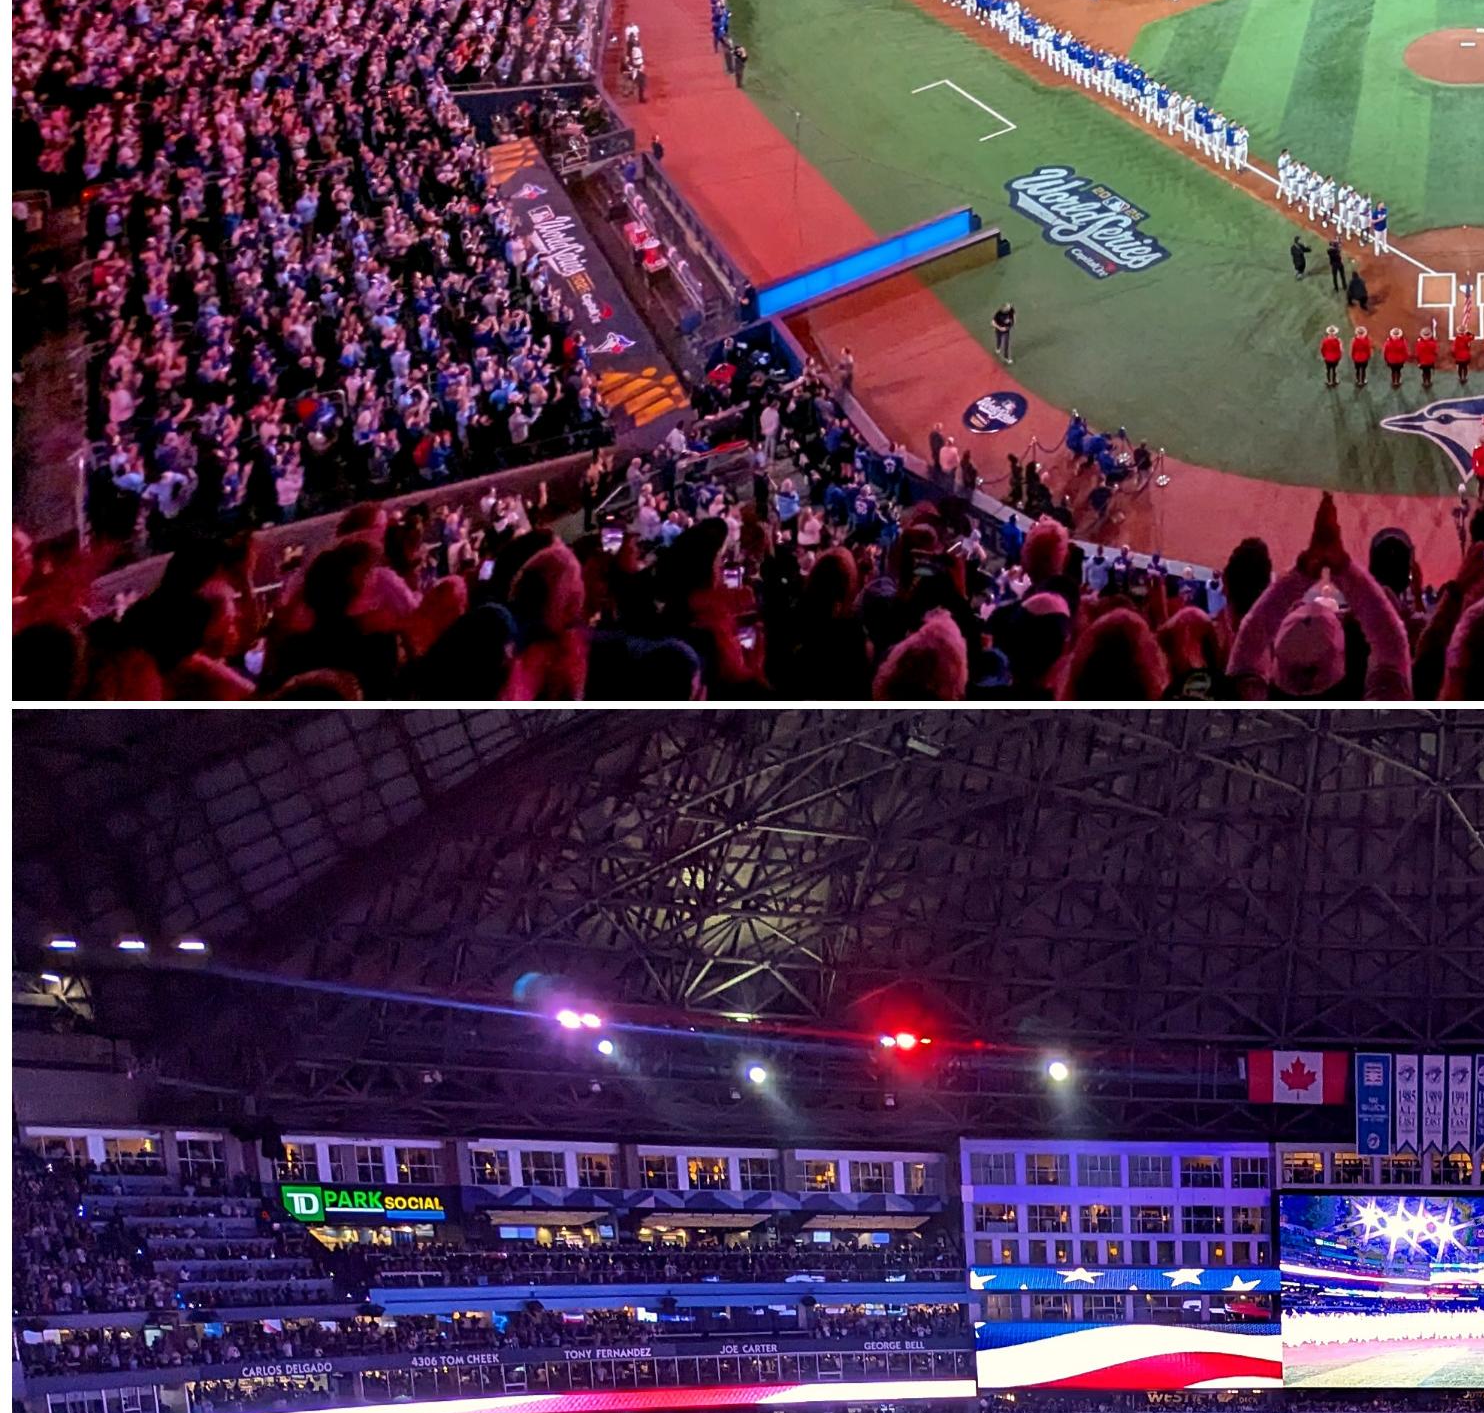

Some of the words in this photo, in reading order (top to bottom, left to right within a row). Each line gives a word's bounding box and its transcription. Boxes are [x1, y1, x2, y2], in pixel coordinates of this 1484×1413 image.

[1010, 167, 1103, 234] World
[1070, 214, 1162, 270] Series
[286, 1192, 320, 1215] TD
[323, 1190, 384, 1208] PARK
[384, 1196, 444, 1211] SOCIAL
[720, 1344, 739, 1355] JOE
[741, 1344, 778, 1353] CARTER
[864, 1341, 901, 1350] GEORGE
[905, 1341, 925, 1350] BELL
[411, 1355, 438, 1366] 4306
[439, 1354, 465, 1365] TOM
[466, 1353, 499, 1364] CHEEK
[564, 1349, 592, 1360] TONY
[596, 1347, 652, 1359] FERNANDEZ
[242, 1365, 282, 1377] CARLOS
[285, 1362, 333, 1375] DELGADO
